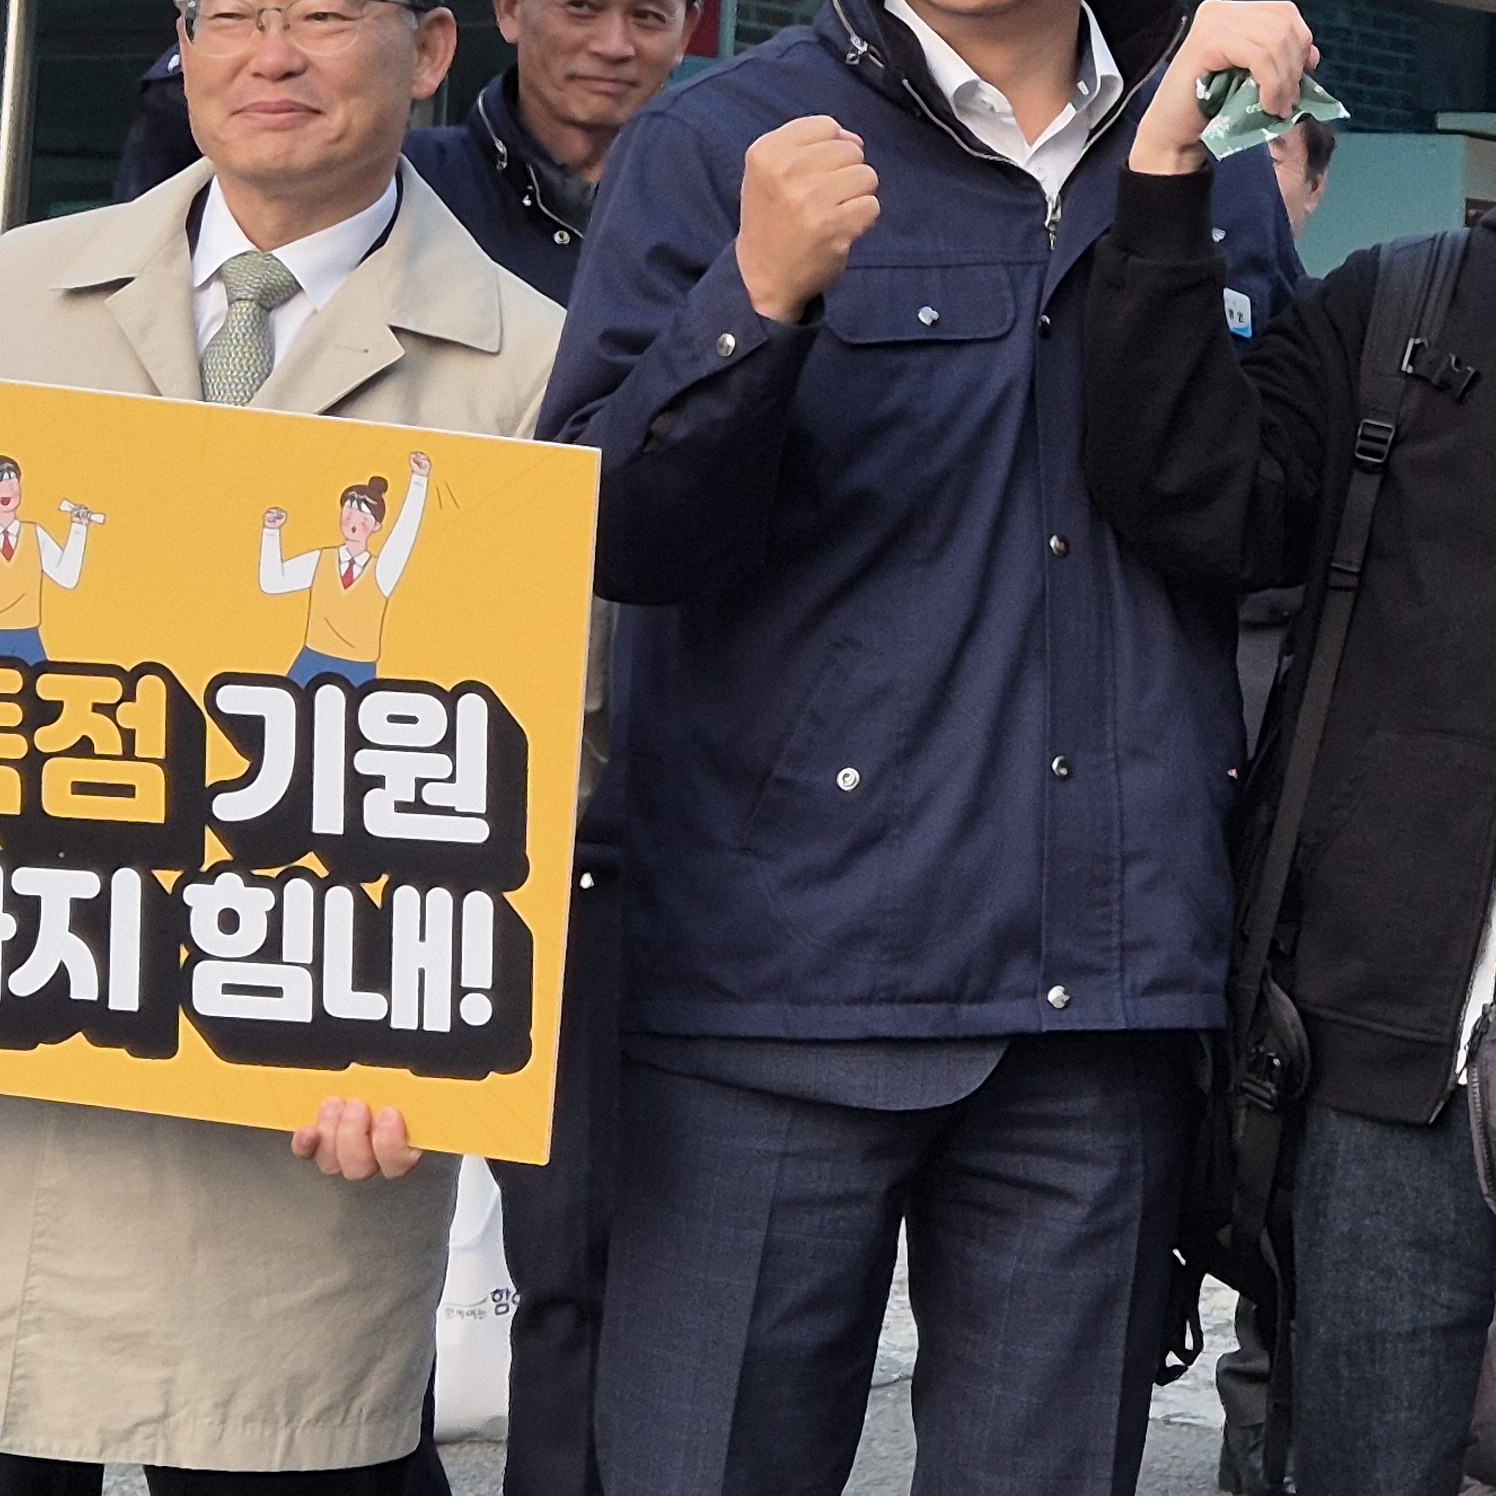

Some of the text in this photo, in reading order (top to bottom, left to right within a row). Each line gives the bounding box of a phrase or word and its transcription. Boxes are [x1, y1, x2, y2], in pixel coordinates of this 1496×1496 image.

[212, 684, 492, 844] 기원
[0, 865, 495, 1033] 지 힘내!
